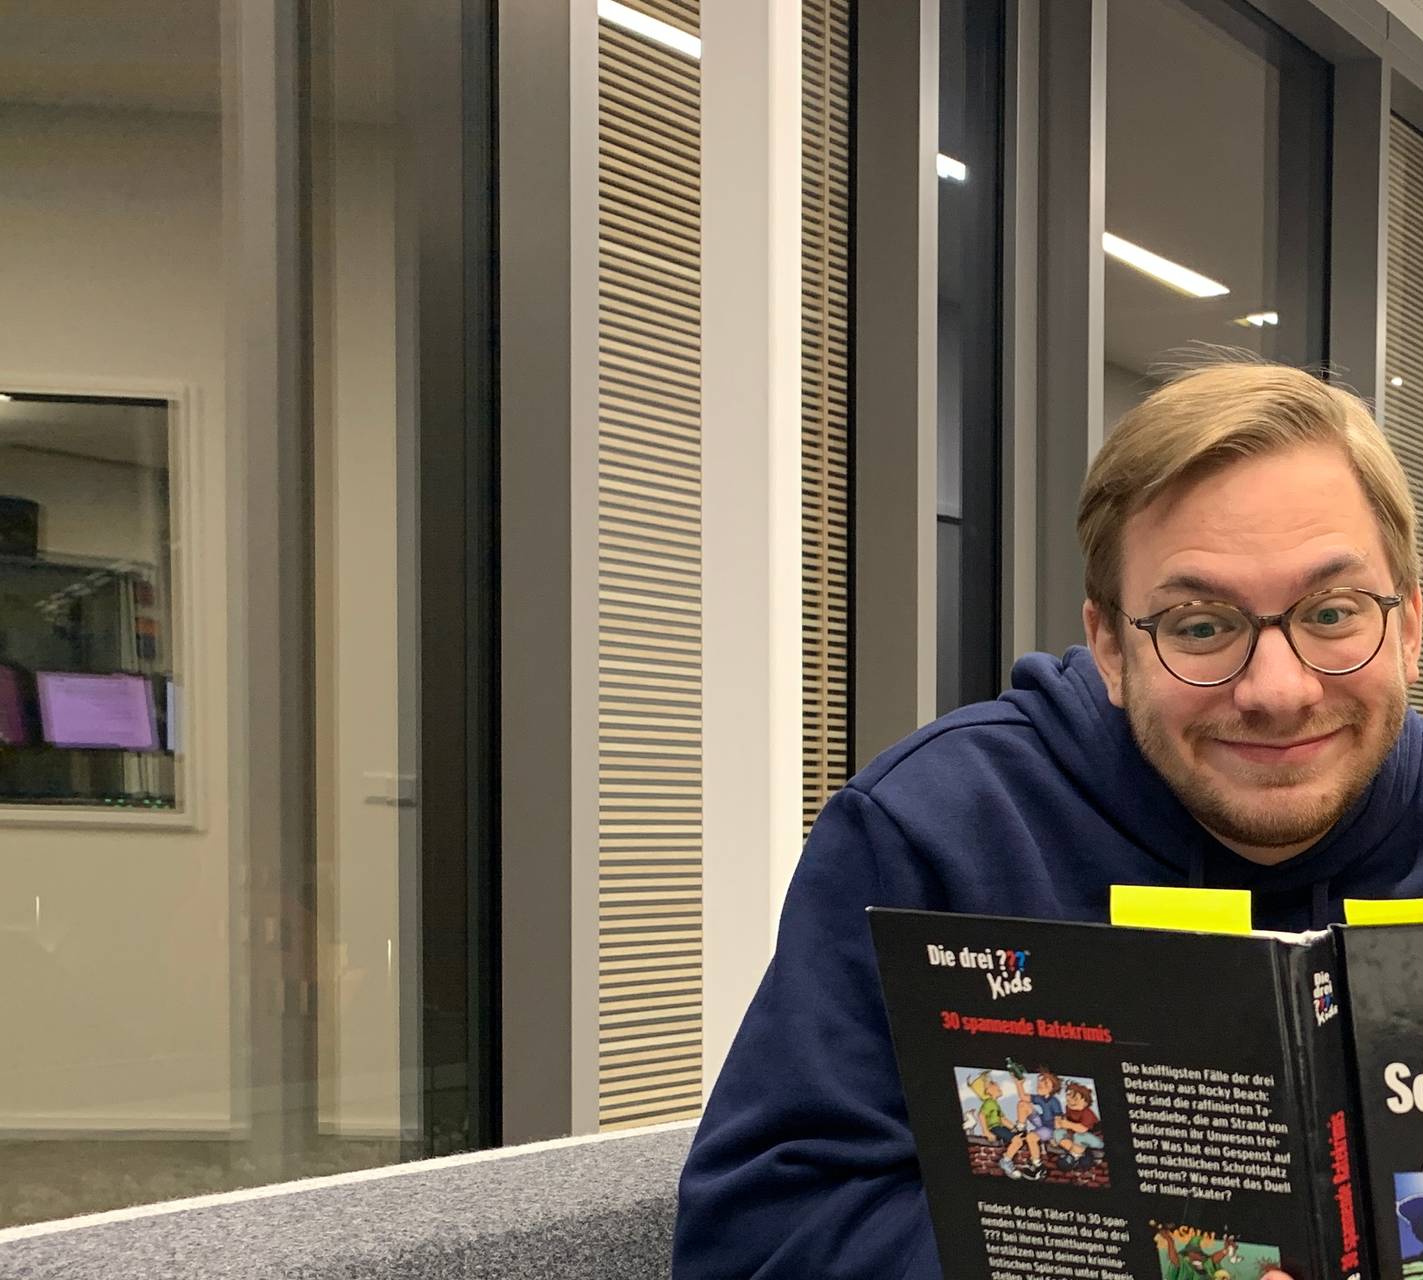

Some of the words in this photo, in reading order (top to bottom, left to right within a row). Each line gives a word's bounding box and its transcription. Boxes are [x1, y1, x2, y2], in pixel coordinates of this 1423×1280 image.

[927, 944, 955, 967] Die
[959, 947, 994, 970] drei
[986, 971, 1032, 1000] Kids
[1313, 980, 1332, 998] drei
[1314, 971, 1329, 985] Die
[1316, 1004, 1338, 1026] Kids
[940, 1011, 960, 1030] 30
[963, 1016, 1034, 1036] spannende
[1037, 1019, 1112, 1043] Ratekrimis
[1121, 1062, 1139, 1074] Die
[1204, 1069, 1229, 1082] Fälle
[1232, 1072, 1249, 1084] der
[1252, 1075, 1274, 1087] drei
[1124, 1078, 1175, 1092] Detektive
[1177, 1084, 1196, 1094] aus
[1198, 1085, 1230, 1098] Rocky
[1126, 1093, 1146, 1104] Wer
[1149, 1097, 1171, 1107] sind
[1173, 1098, 1190, 1108] die
[1131, 1123, 1187, 1138] Kalifornien
[1190, 1128, 1204, 1140] ihr
[1207, 1130, 1254, 1145] Unwesen
[1192, 1114, 1209, 1125] die
[1212, 1118, 1228, 1127] am
[1231, 1118, 1266, 1130] Strand
[1269, 1123, 1288, 1133] von
[1133, 1139, 1158, 1150] ben?
[1161, 1141, 1182, 1151] Was
[1184, 1142, 1201, 1154] hat
[1204, 1145, 1220, 1155] ein
[1222, 1147, 1271, 1161] Gespenst
[1274, 1152, 1290, 1163] auf
[1135, 1153, 1158, 1164] dem
[1222, 1161, 1287, 1177] Schrottplatz
[1140, 1182, 1157, 1192] der
[1190, 1172, 1208, 1184] Wie
[1211, 1174, 1240, 1187] endet
[1243, 1179, 1262, 1190] das
[978, 1202, 1011, 1215] Findest
[1014, 1206, 1026, 1216] du
[1027, 1208, 1042, 1218] die
[1088, 1213, 1100, 1224] 30
[984, 1229, 1000, 1240] ???
[1003, 1231, 1018, 1242] bei
[1016, 1220, 1045, 1232] Krimis
[1080, 1227, 1092, 1237] du
[1094, 1228, 1109, 1239] die
[1110, 1230, 1130, 1242] drei
[1036, 1248, 1053, 1260] und
[1055, 1252, 1086, 1264] deinen
